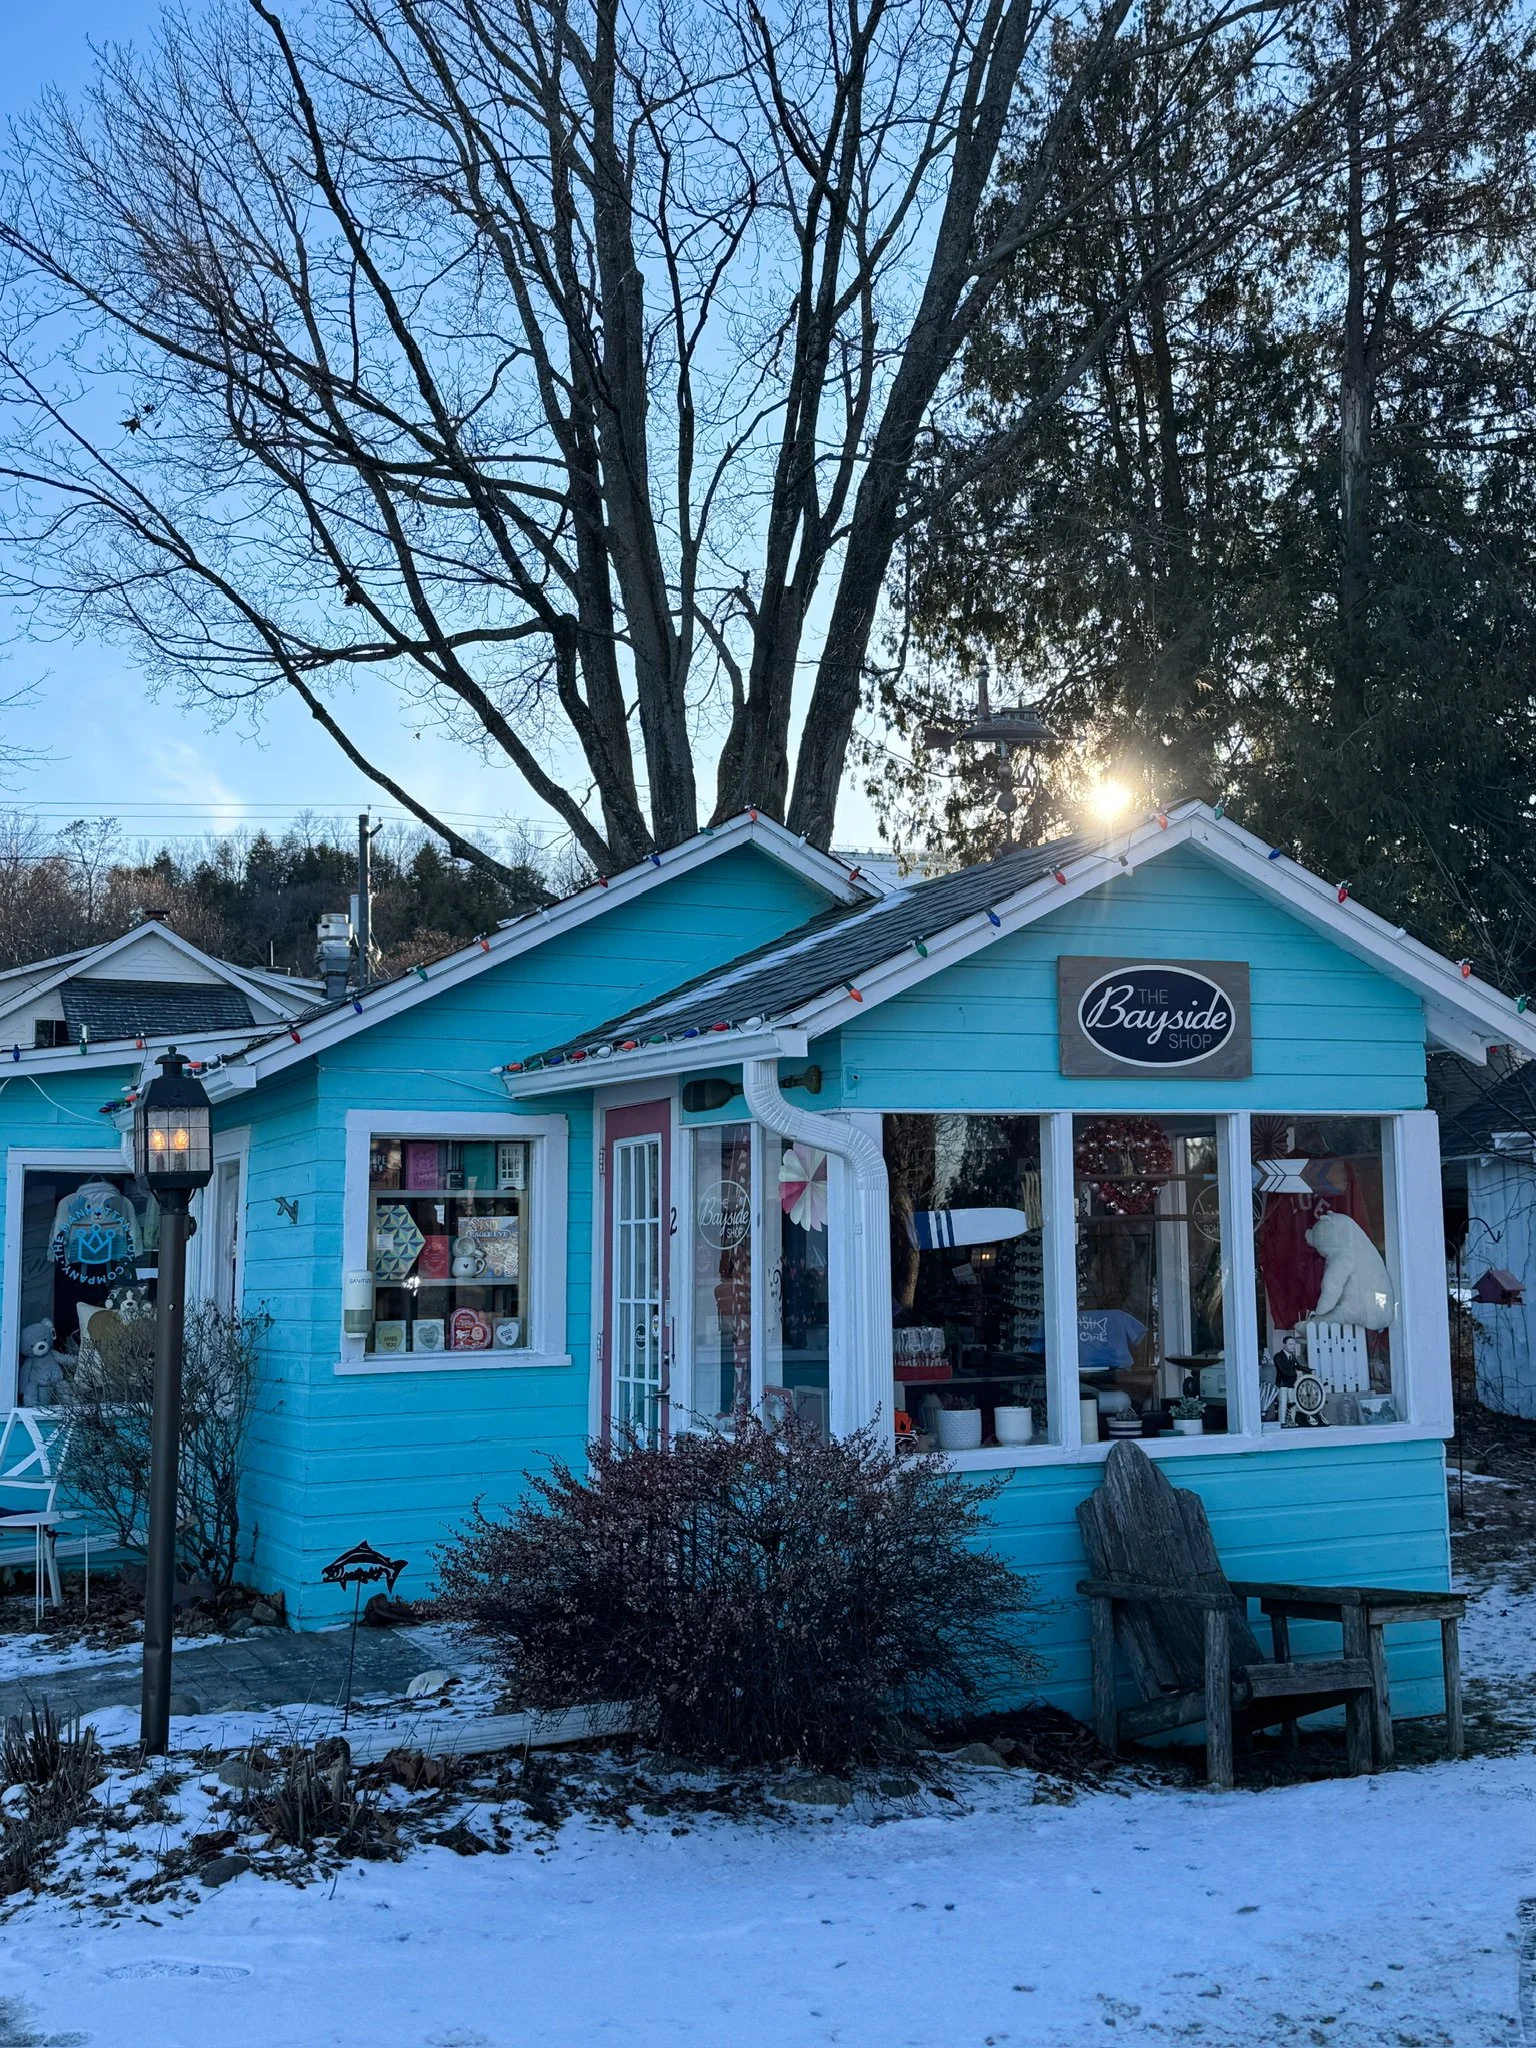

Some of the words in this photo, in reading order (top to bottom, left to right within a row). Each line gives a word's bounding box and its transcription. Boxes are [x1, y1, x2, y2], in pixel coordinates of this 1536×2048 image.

[1138, 989, 1168, 1004] THE
[1086, 985, 1227, 1045] Bayside
[1169, 1034, 1212, 1049] SHOP
[670, 1206, 678, 1236] 2
[700, 1196, 750, 1235] Bayside
[727, 1227, 744, 1238] SHOP
[54, 1234, 65, 1261] THE
[126, 1235, 136, 1261] TOY
[62, 1265, 125, 1285] COMPANY
